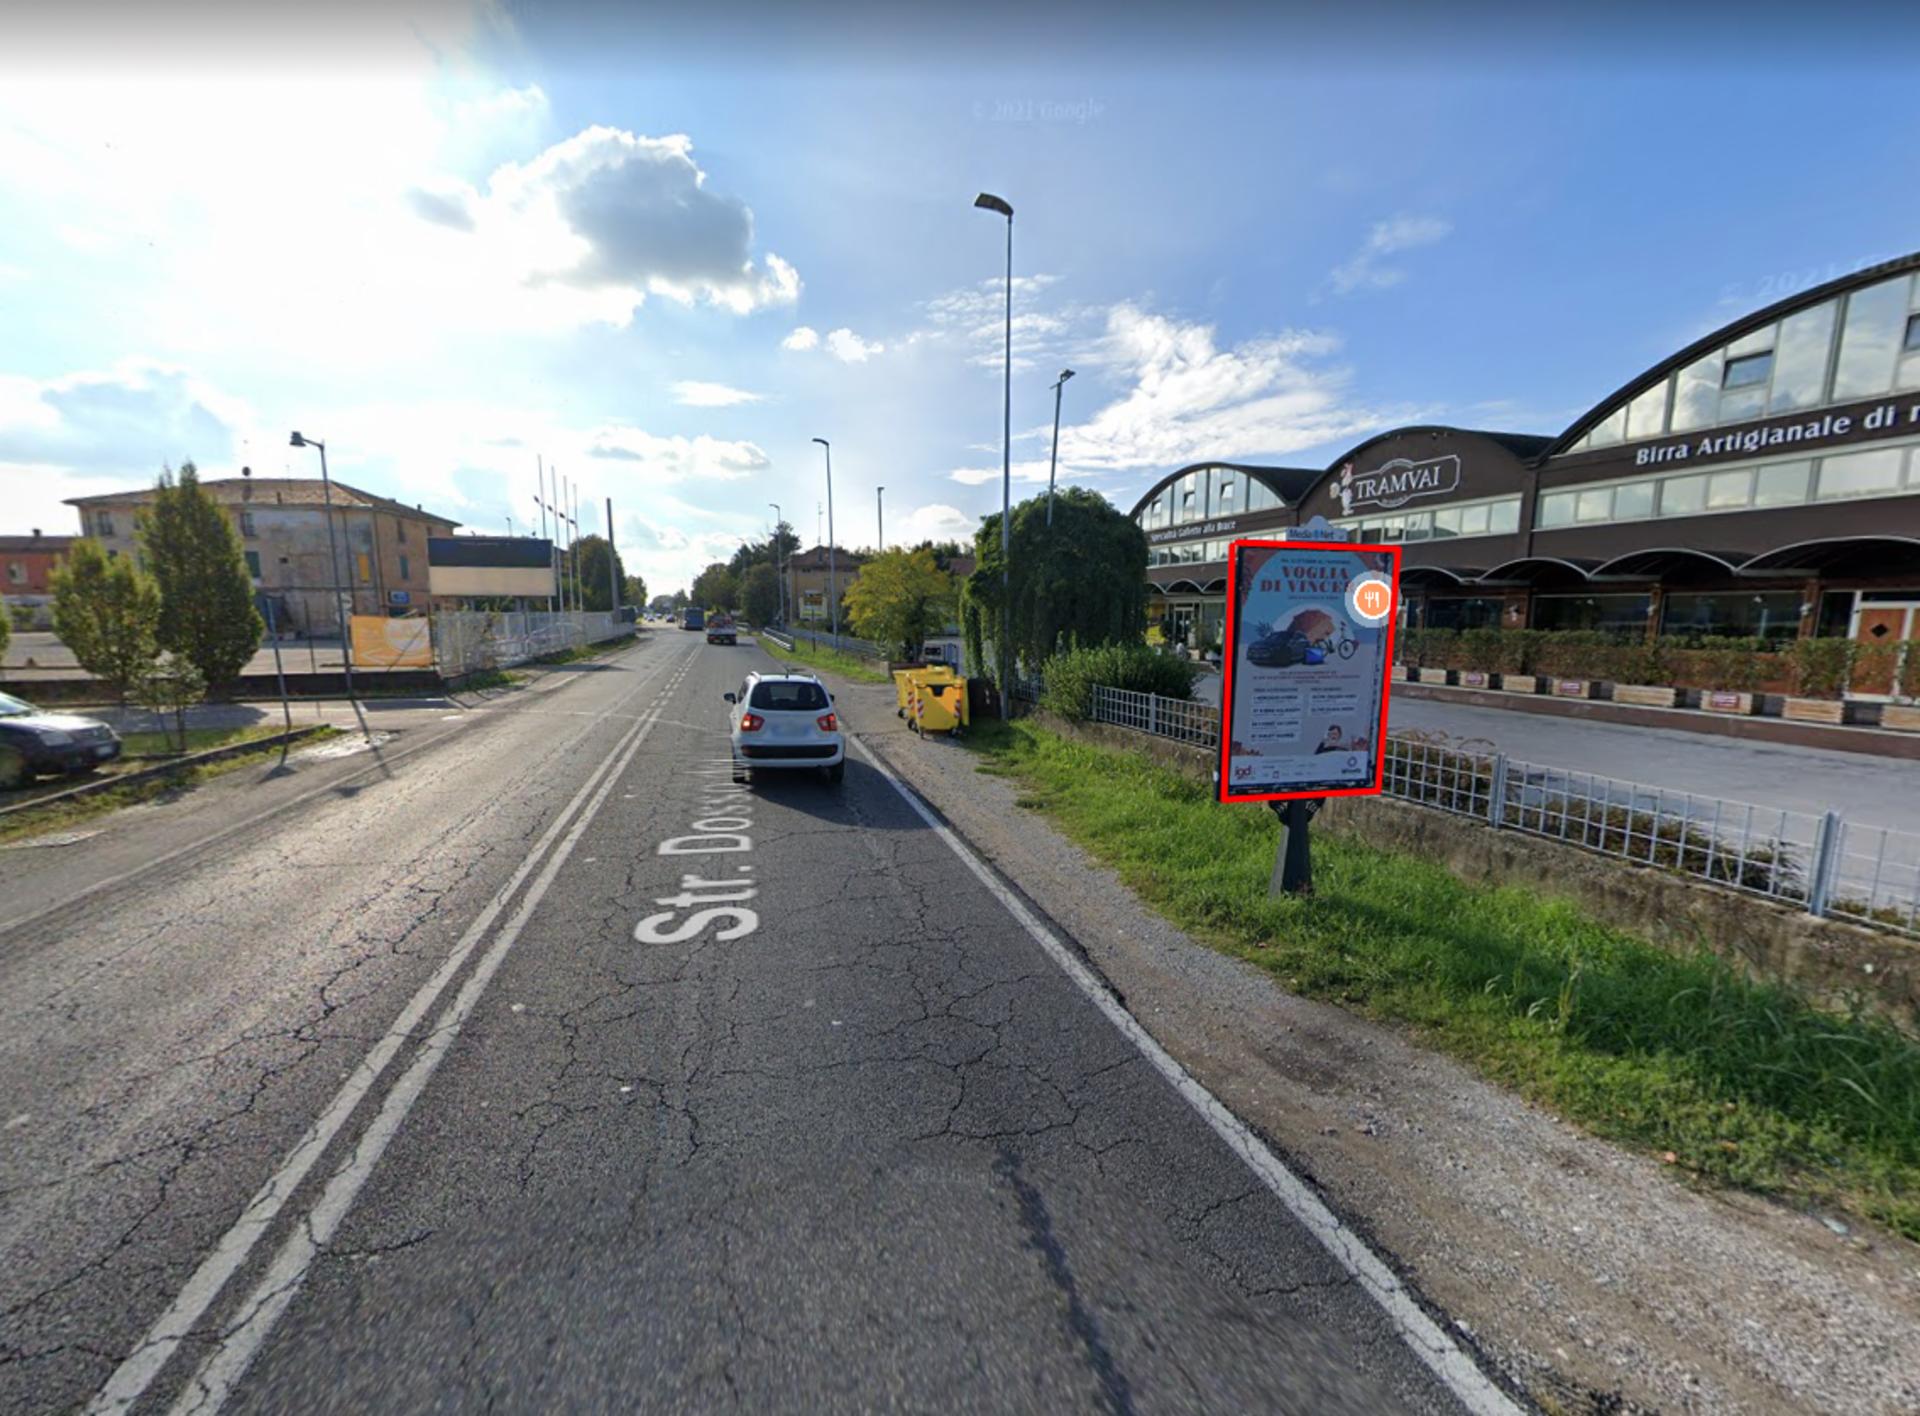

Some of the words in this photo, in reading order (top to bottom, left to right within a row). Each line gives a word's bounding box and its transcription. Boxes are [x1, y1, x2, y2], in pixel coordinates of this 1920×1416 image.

[1635, 443, 1690, 465] Birra
[1696, 415, 1852, 456] Artigianale
[1863, 405, 1896, 429] di
[1355, 466, 1441, 499] TRAMVAI
[1282, 565, 1349, 579] VOGLIA
[1260, 579, 1281, 592] DI
